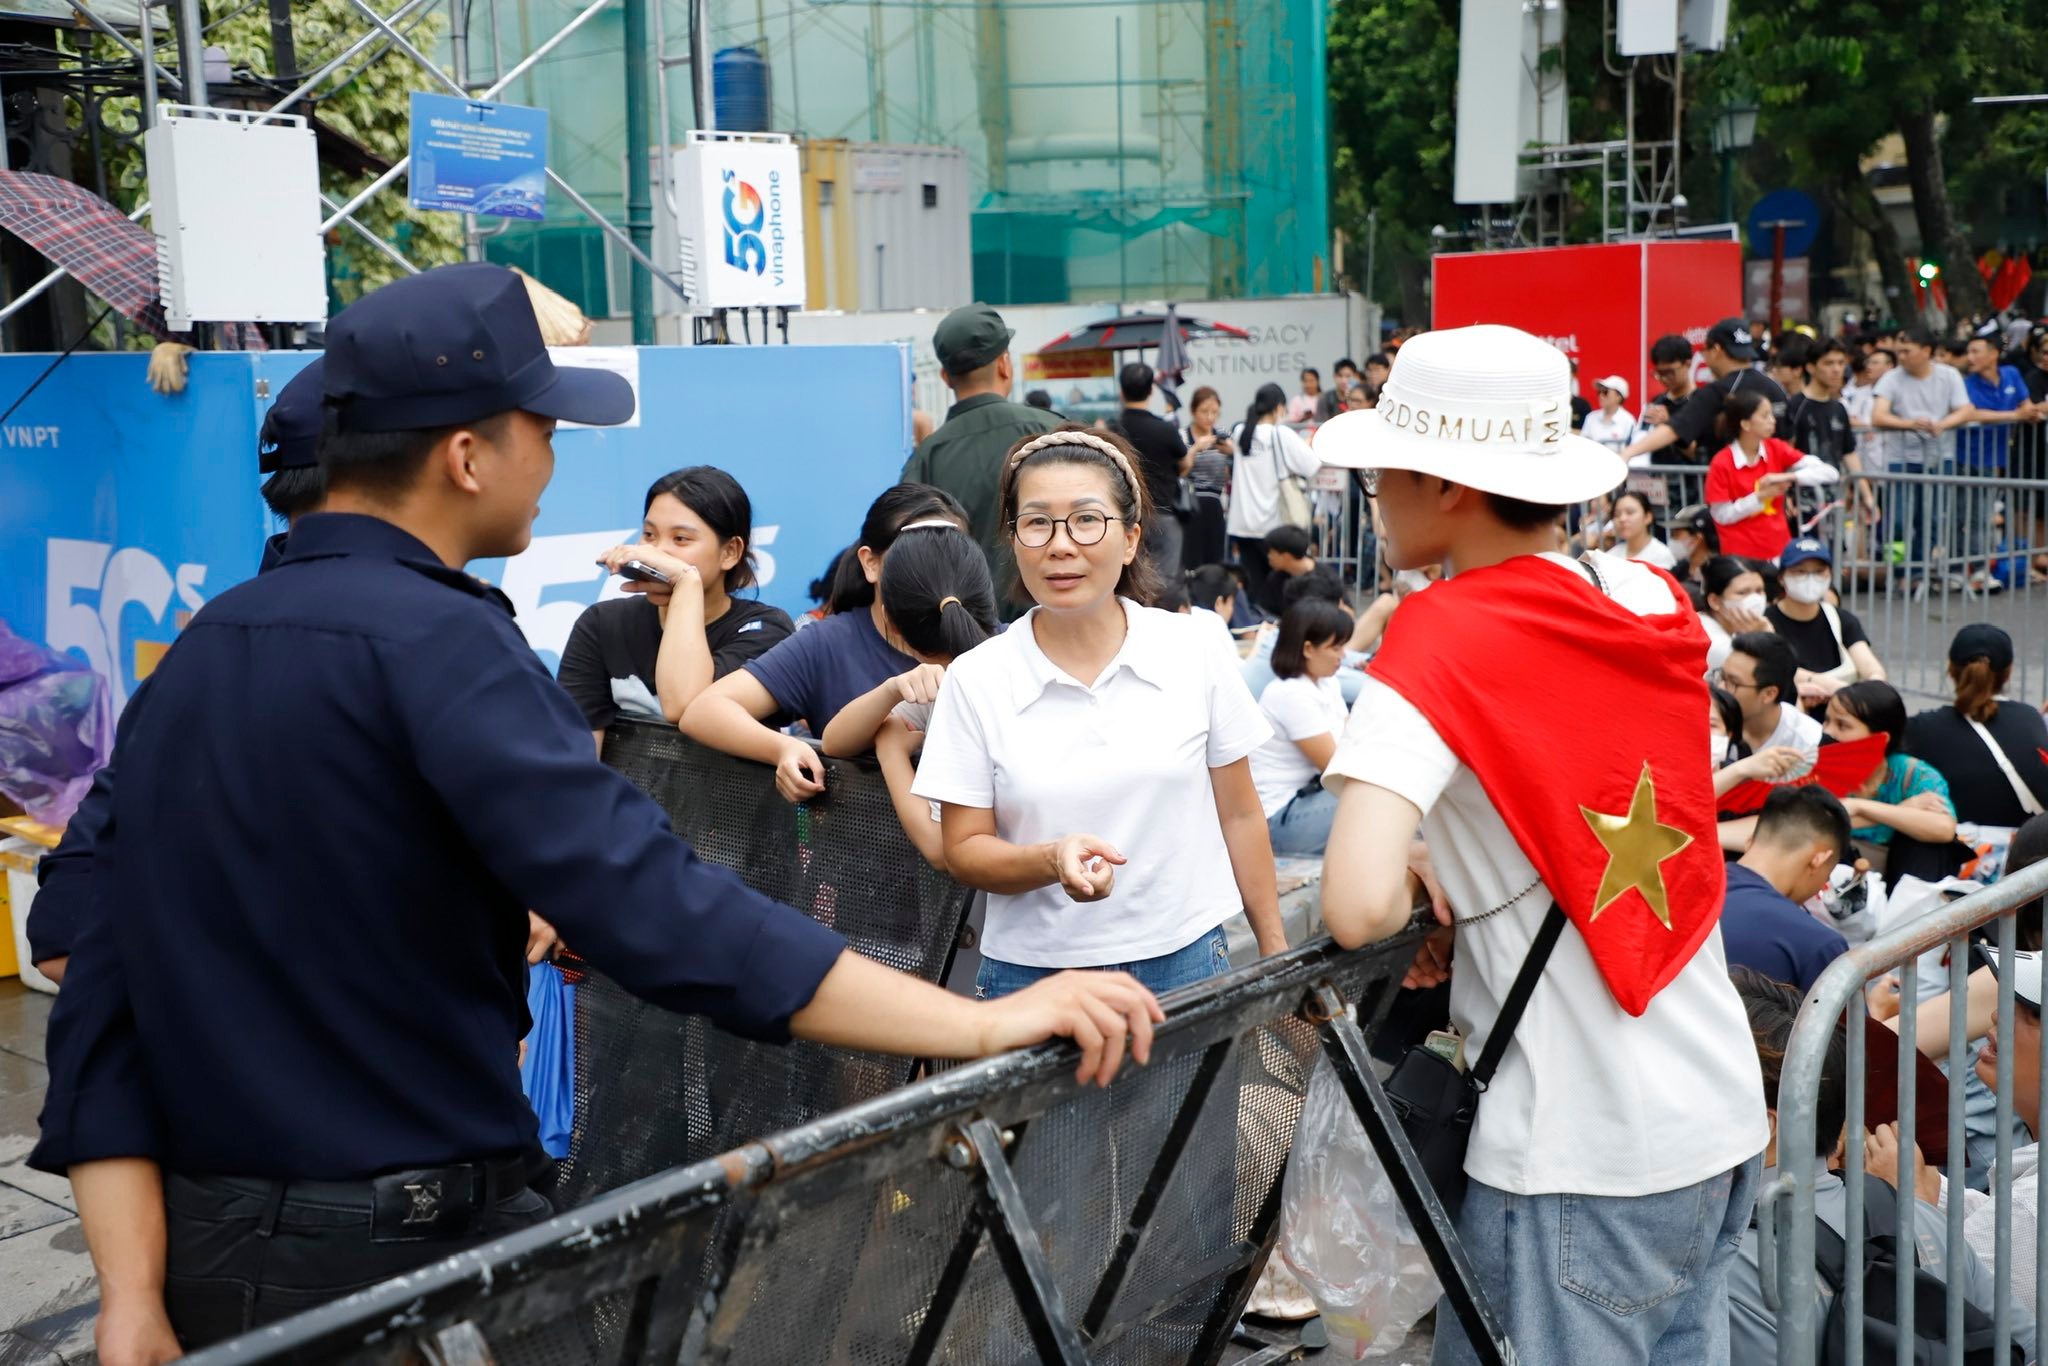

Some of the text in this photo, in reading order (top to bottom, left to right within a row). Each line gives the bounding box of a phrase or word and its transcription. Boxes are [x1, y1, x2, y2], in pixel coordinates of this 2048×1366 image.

[769, 170, 785, 287] vinaphone
[1184, 350, 1307, 377] ONTINUES
[3, 425, 60, 448] VNPT
